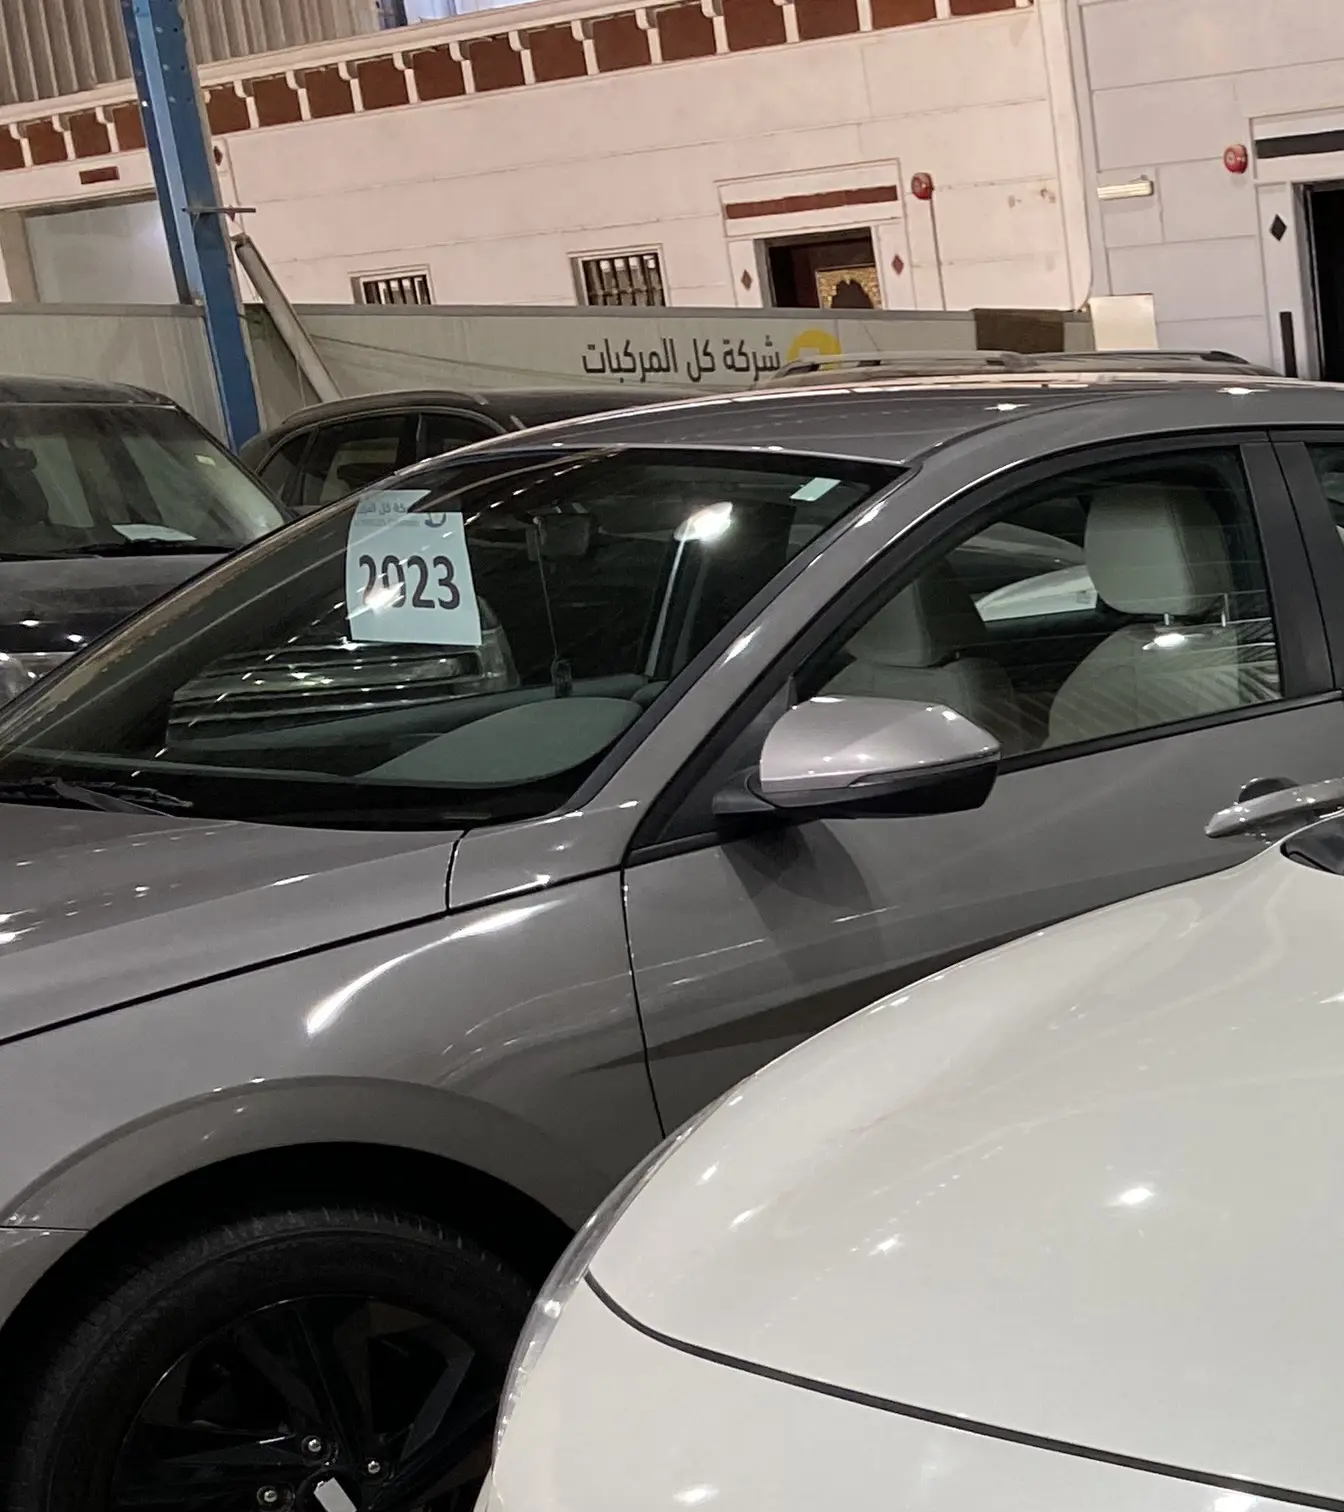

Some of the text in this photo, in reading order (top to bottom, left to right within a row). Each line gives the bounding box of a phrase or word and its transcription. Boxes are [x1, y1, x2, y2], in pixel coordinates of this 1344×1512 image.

[581, 335, 781, 384] شركة كل المركبات
[358, 554, 461, 610] 2023
